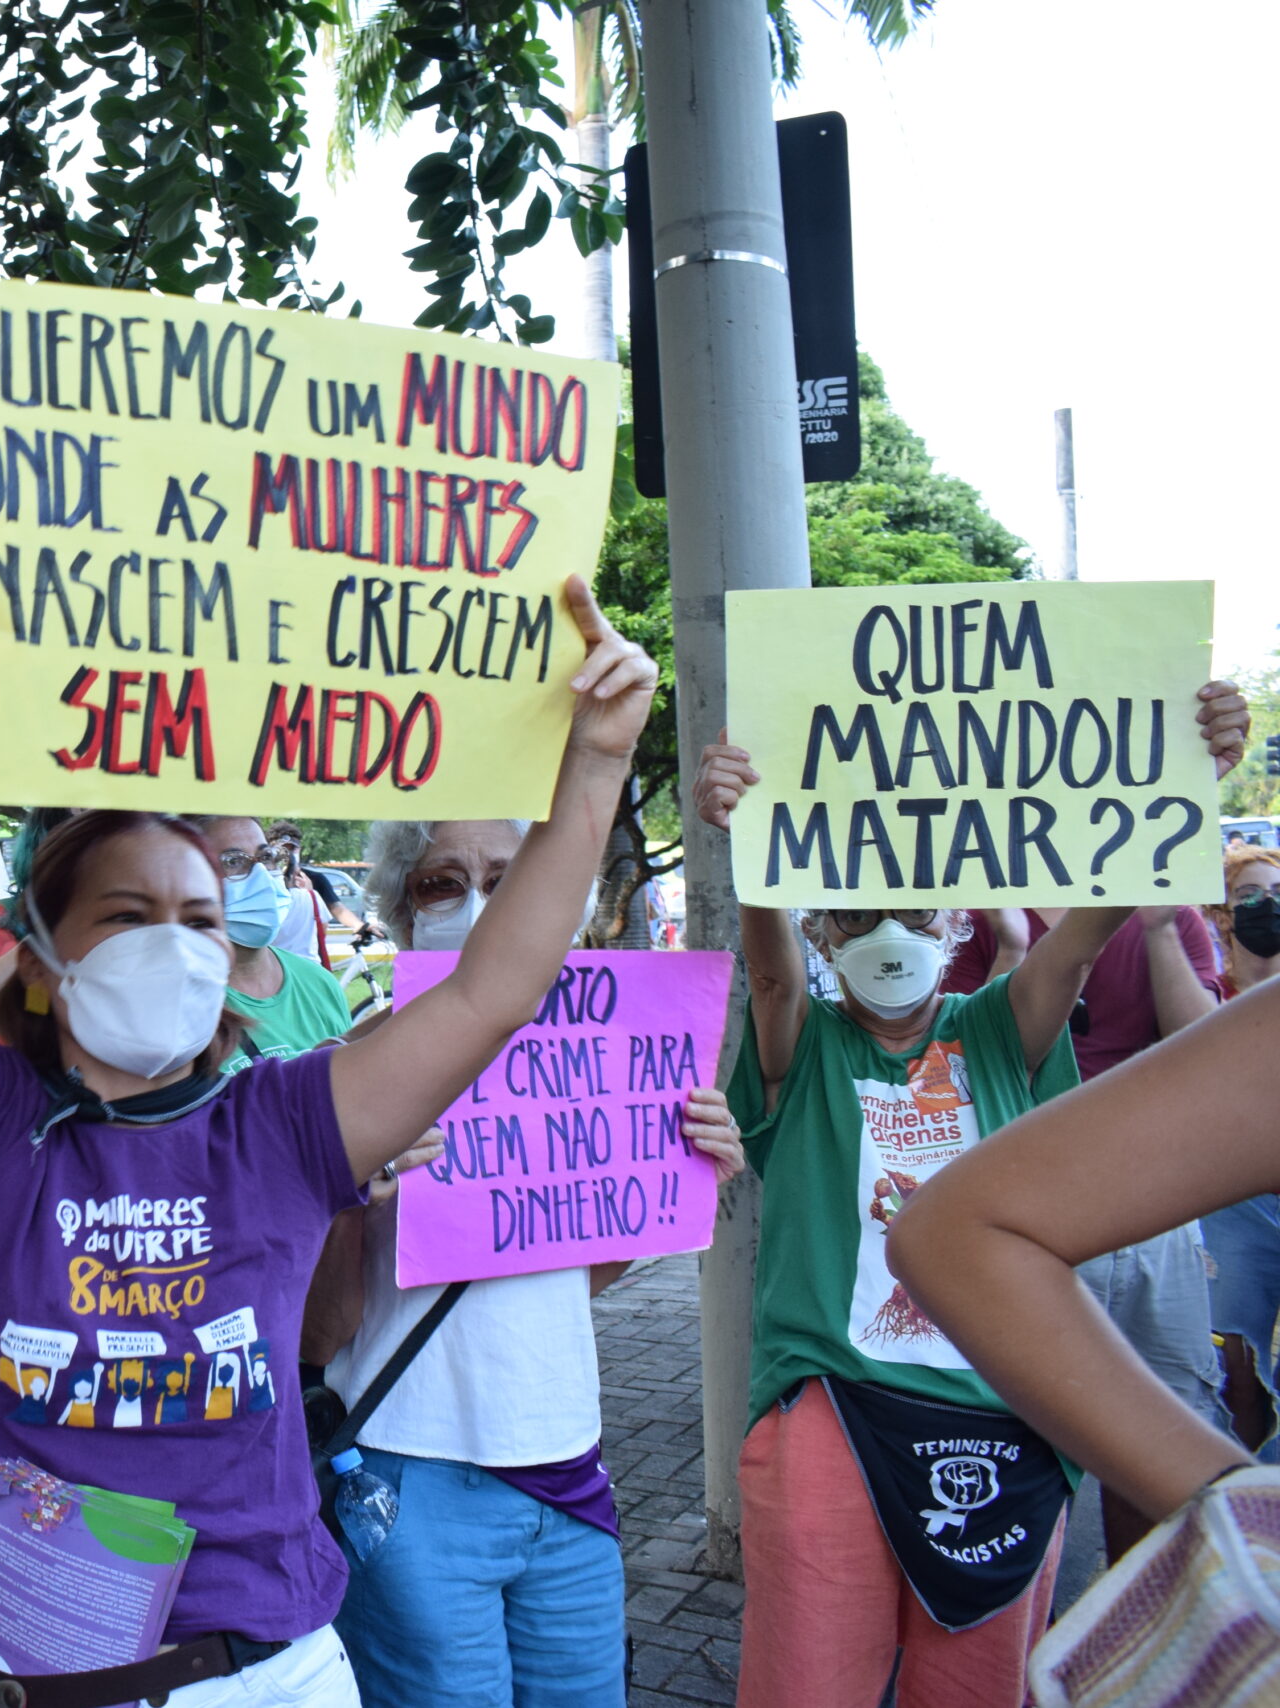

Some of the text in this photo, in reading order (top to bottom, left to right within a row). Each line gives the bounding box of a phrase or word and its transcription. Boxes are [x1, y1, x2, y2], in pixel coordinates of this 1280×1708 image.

[306, 376, 386, 444] UM
[396, 352, 588, 472] MUNDO
[799, 407, 848, 419] ENHARIA
[156, 472, 228, 543] AS
[247, 451, 540, 578] MULHERES
[269, 599, 297, 664] E
[326, 575, 553, 684] CRESCEM
[852, 599, 1054, 704] QUEM
[48, 665, 442, 791] SEM MEDO
[800, 697, 1165, 792] MANDOU
[881, 961, 903, 973] 3M
[628, 1032, 700, 1092] PARA
[544, 1098, 612, 1172] NÃO
[625, 1100, 691, 1161] TEM
[84, 1227, 214, 1264] da UFRPE
[69, 1256, 119, 1315] 8 DE
[99, 1275, 206, 1320] MARÇO
[912, 1439, 1021, 1461] FEMINISTAS
